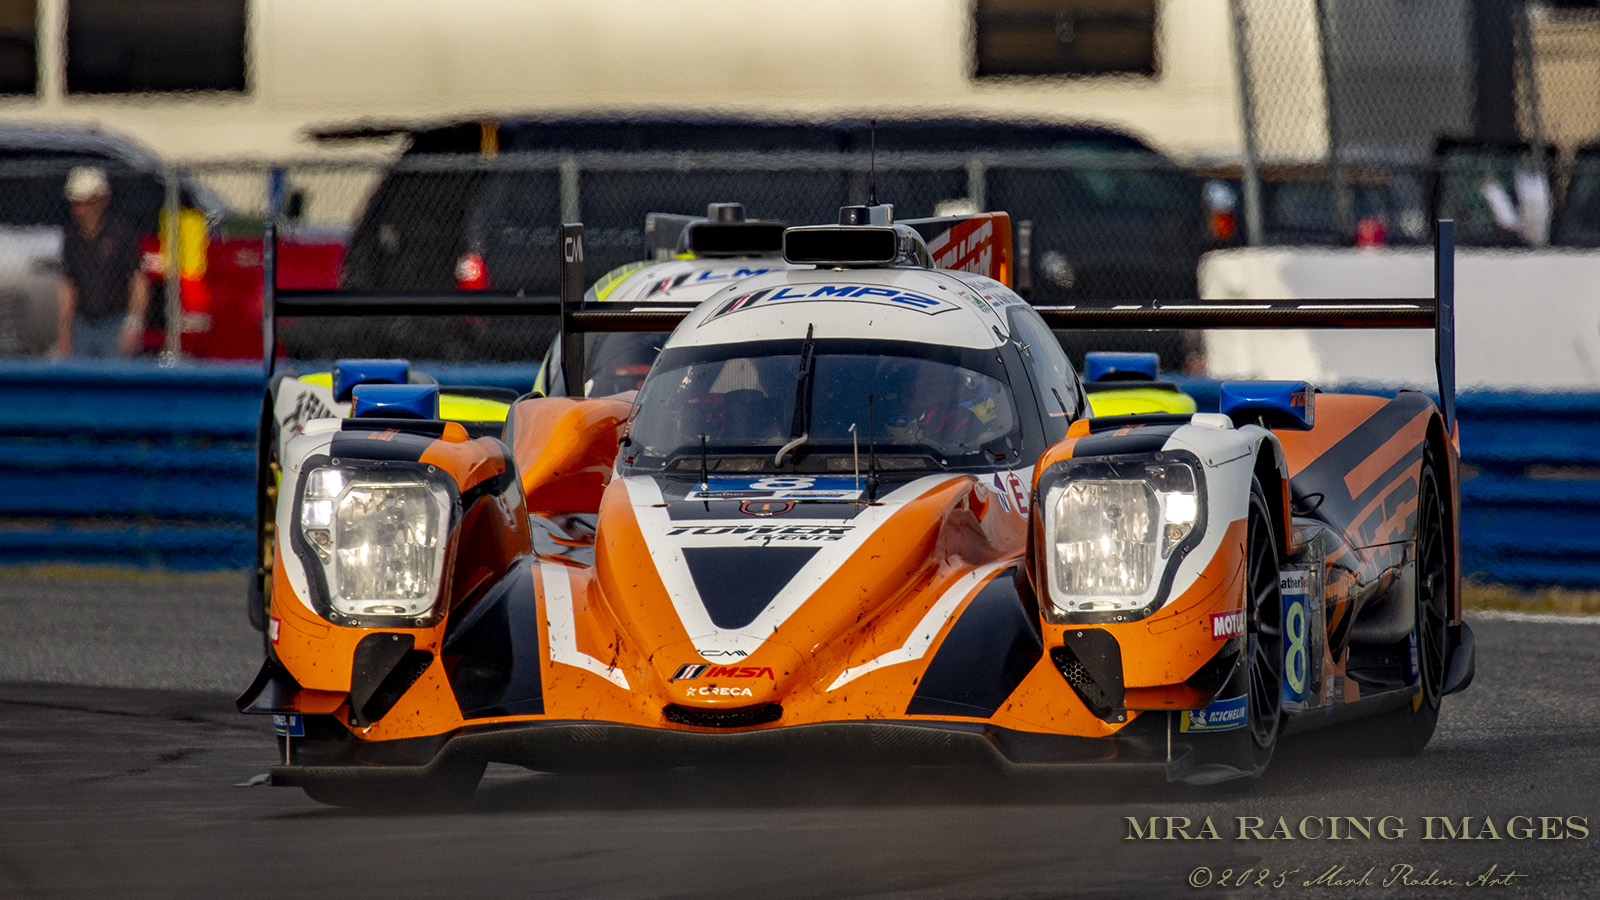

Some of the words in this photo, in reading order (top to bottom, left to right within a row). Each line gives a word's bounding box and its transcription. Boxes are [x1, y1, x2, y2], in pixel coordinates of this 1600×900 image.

[767, 285, 941, 309] LMP2
[749, 477, 817, 491] 8
[666, 525, 856, 536] TOWER
[744, 534, 846, 542] EVENTS
[1285, 601, 1307, 694] 8
[704, 666, 775, 681] IMSA
[1208, 705, 1246, 723] MICHELIN
